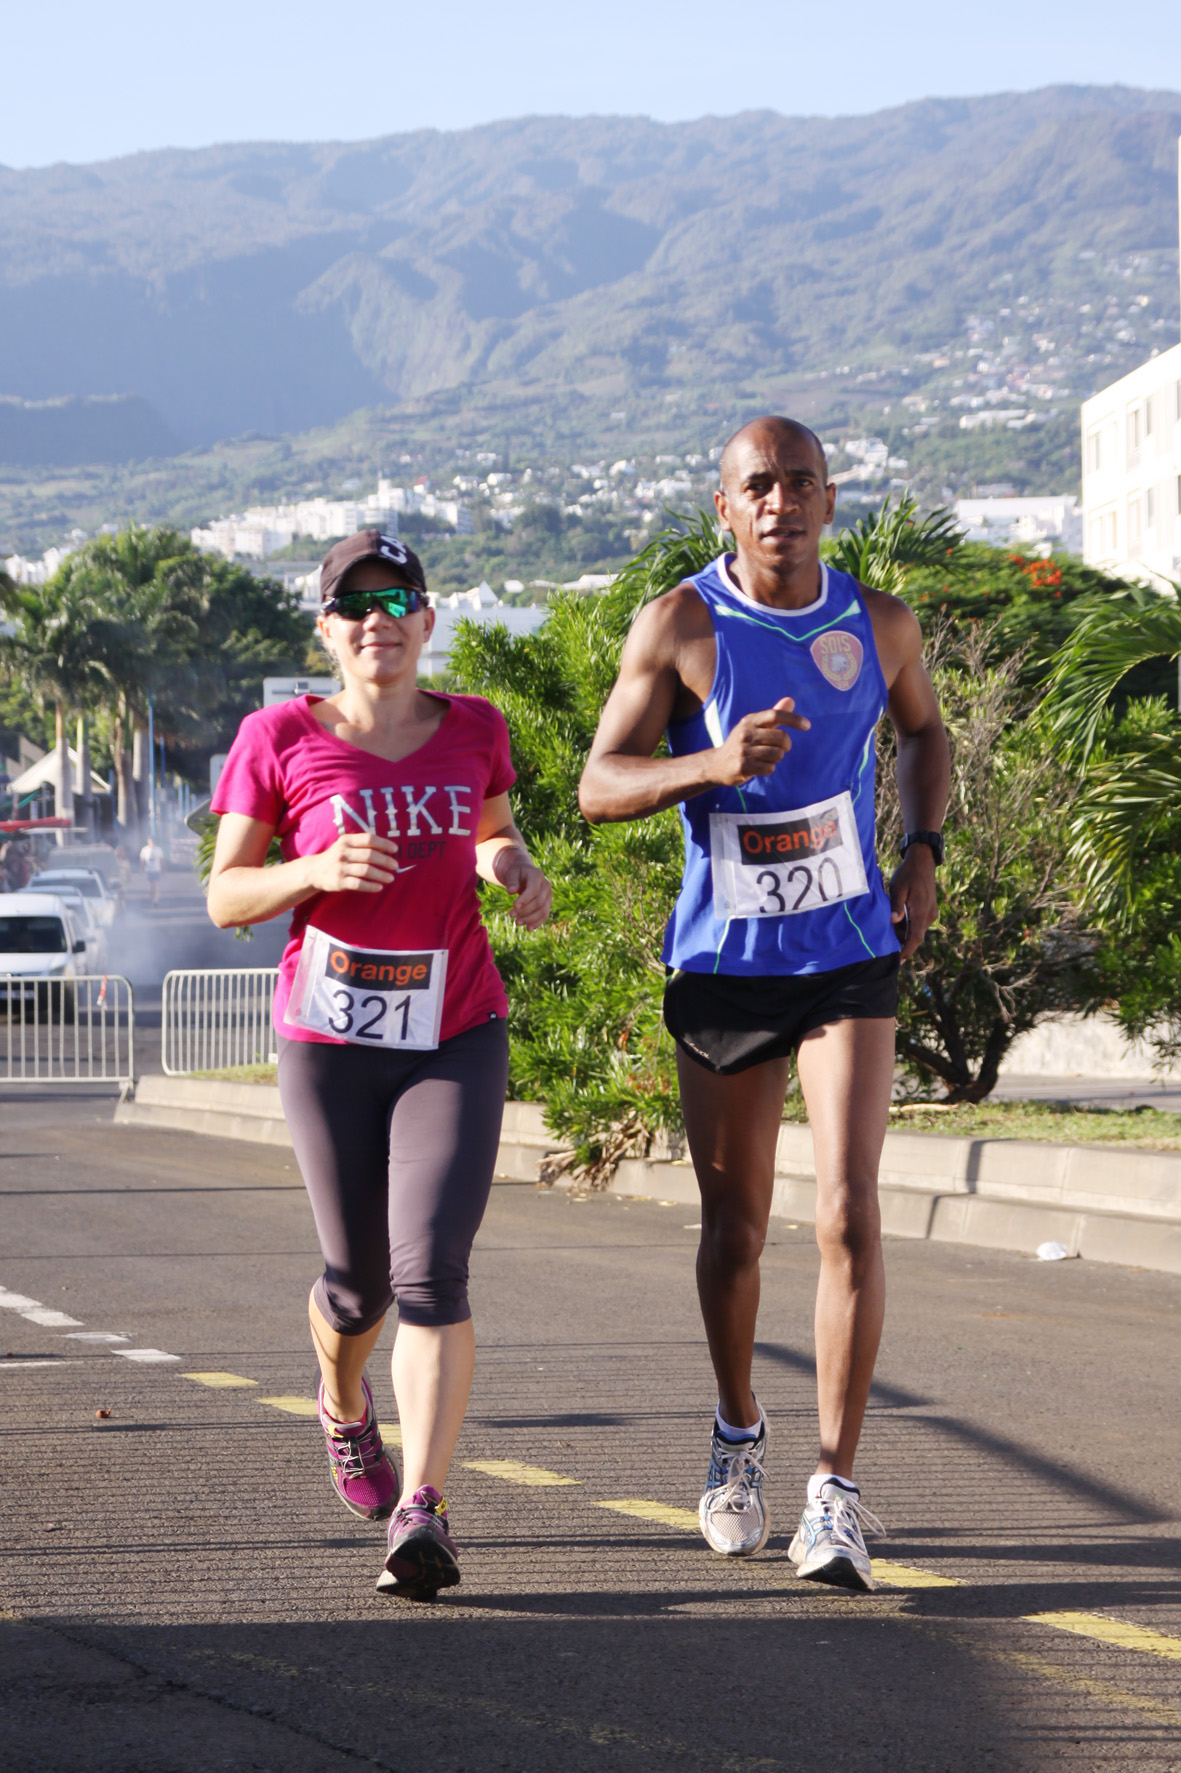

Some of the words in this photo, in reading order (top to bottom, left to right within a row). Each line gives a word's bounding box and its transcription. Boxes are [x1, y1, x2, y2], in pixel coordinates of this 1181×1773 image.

[820, 635, 851, 654] SDIS
[330, 785, 472, 837] NIKE
[408, 841, 447, 859] DEPT
[743, 820, 837, 854] Orange
[756, 857, 843, 913] 320
[330, 950, 428, 986] Orange
[328, 990, 411, 1041] 321
